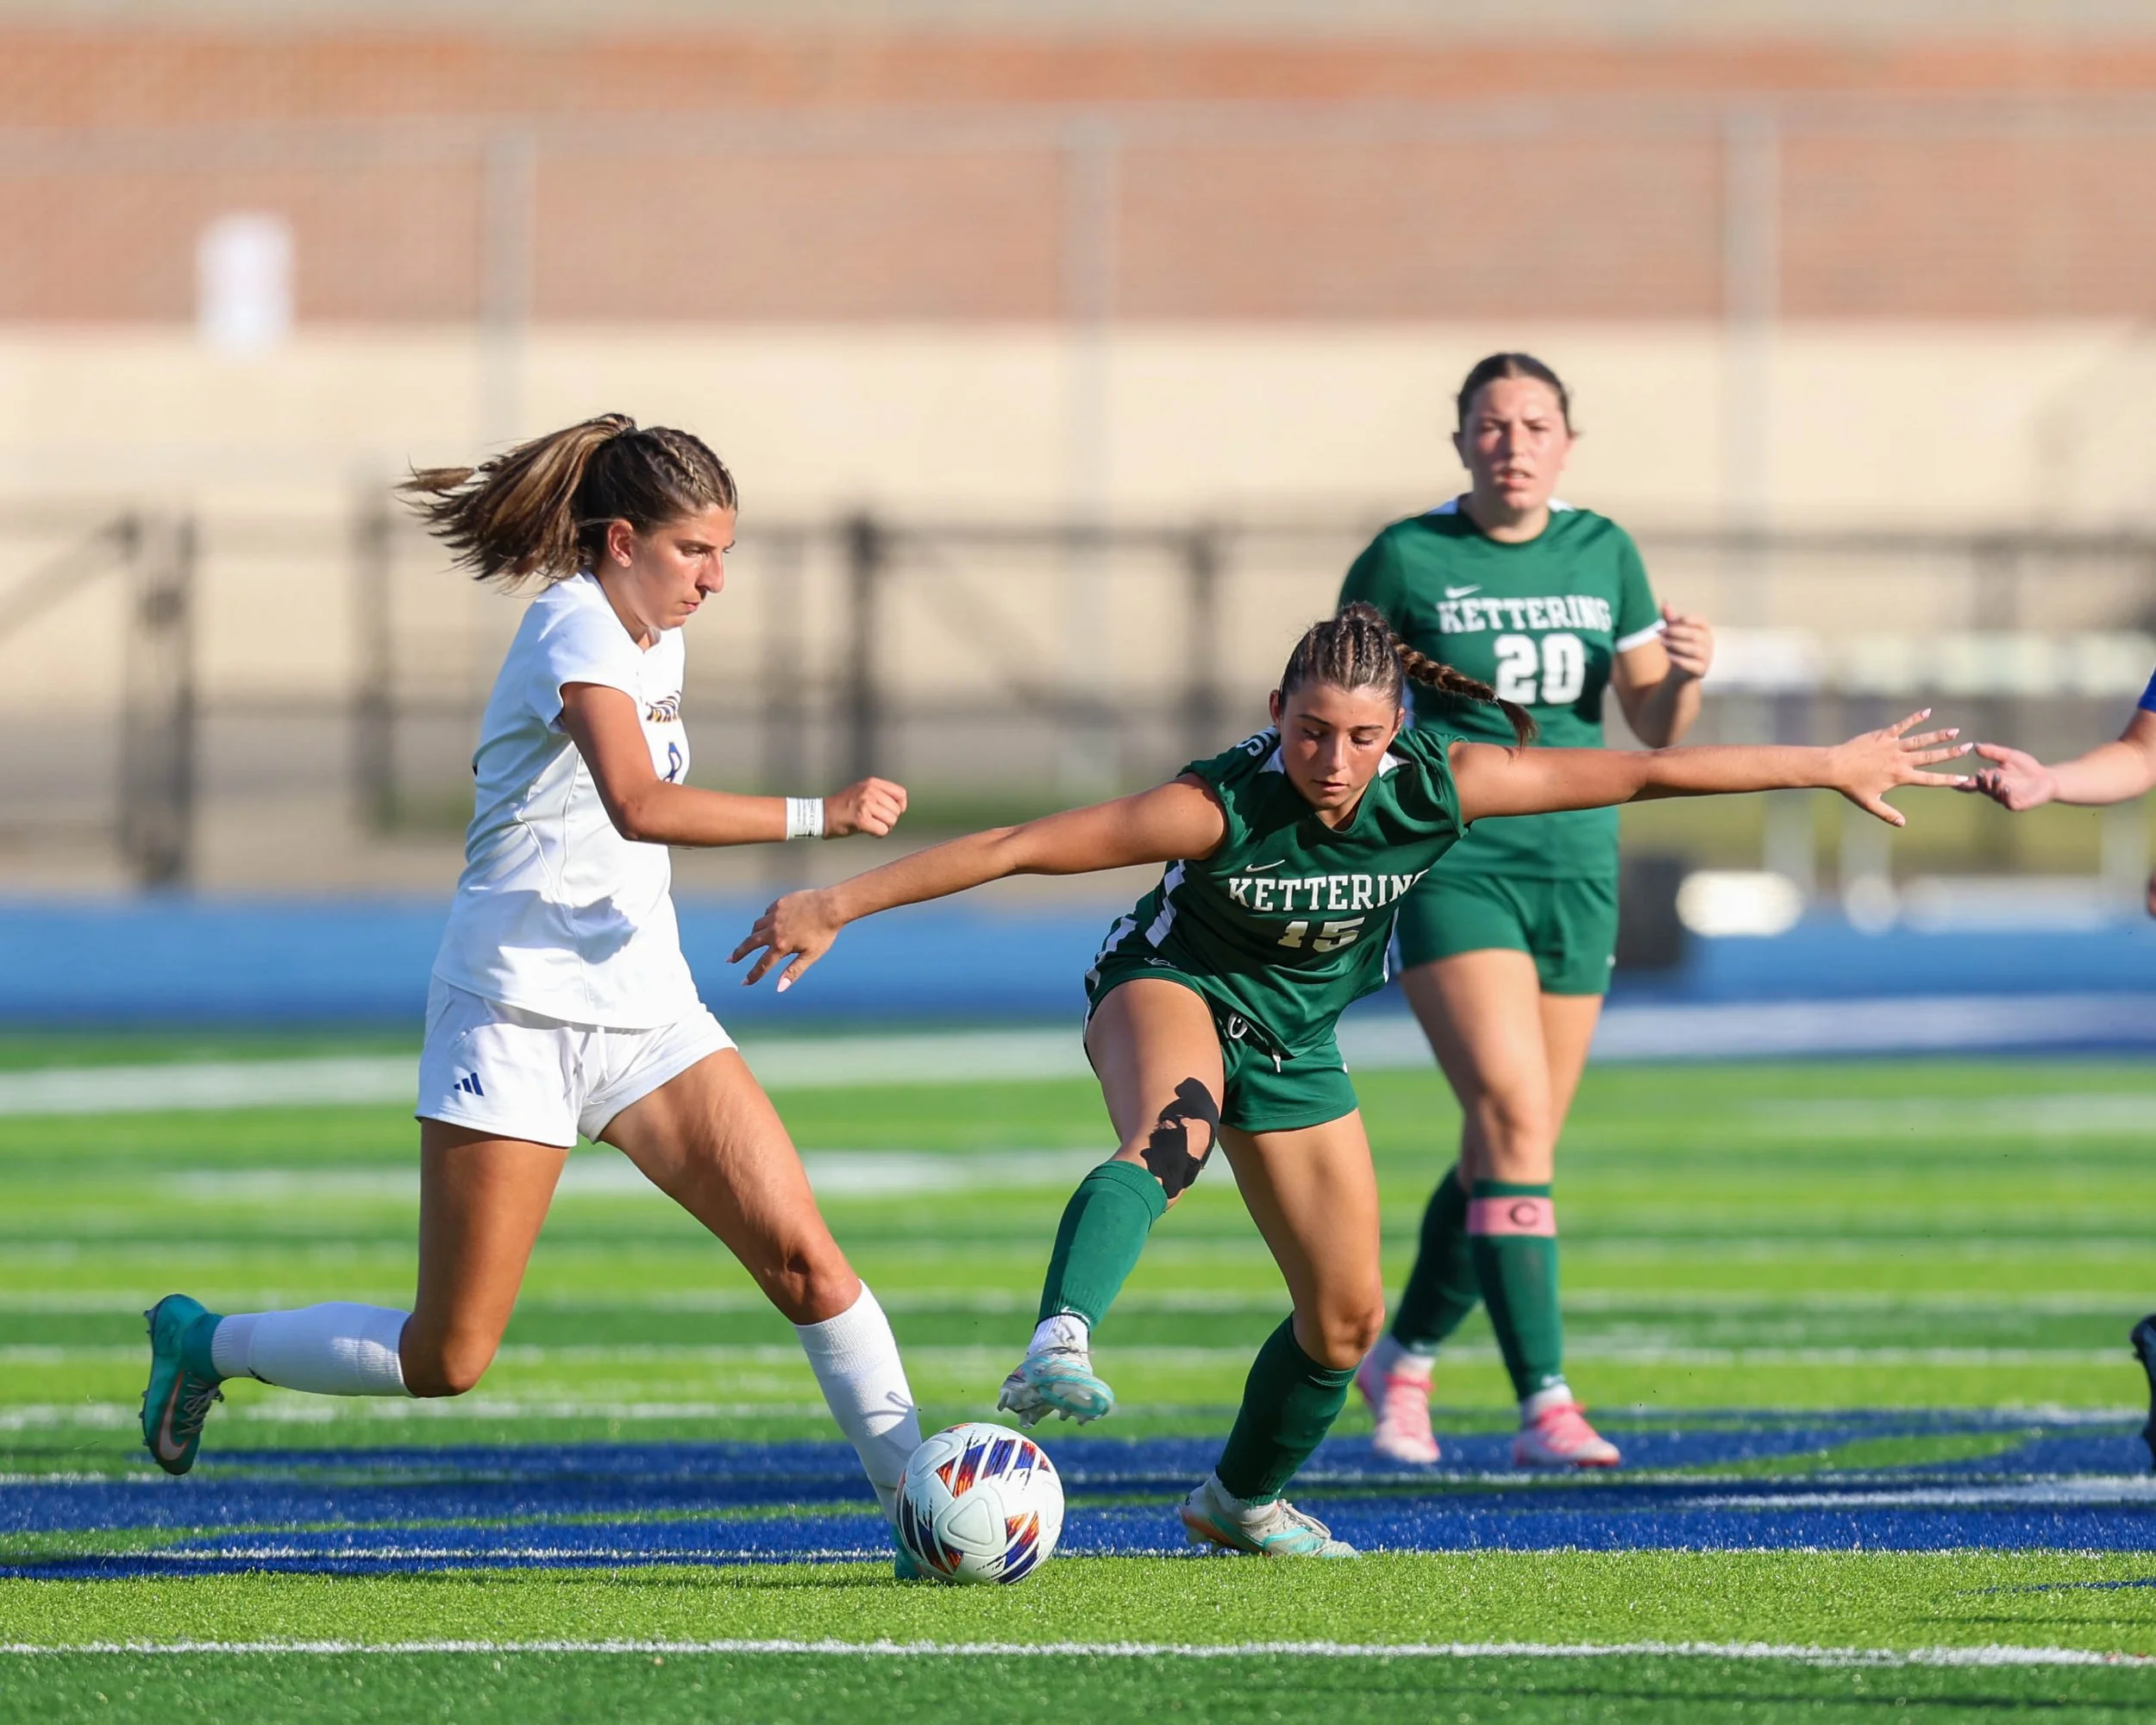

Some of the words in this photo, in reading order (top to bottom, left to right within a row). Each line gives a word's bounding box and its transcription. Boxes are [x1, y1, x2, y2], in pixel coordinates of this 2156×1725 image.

[1437, 595, 1613, 633] KETTERING
[1494, 633, 1585, 704] 20
[1228, 869, 1428, 912] KETTERIN
[1277, 917, 1365, 952] 15
[1508, 1200, 1539, 1227] C
